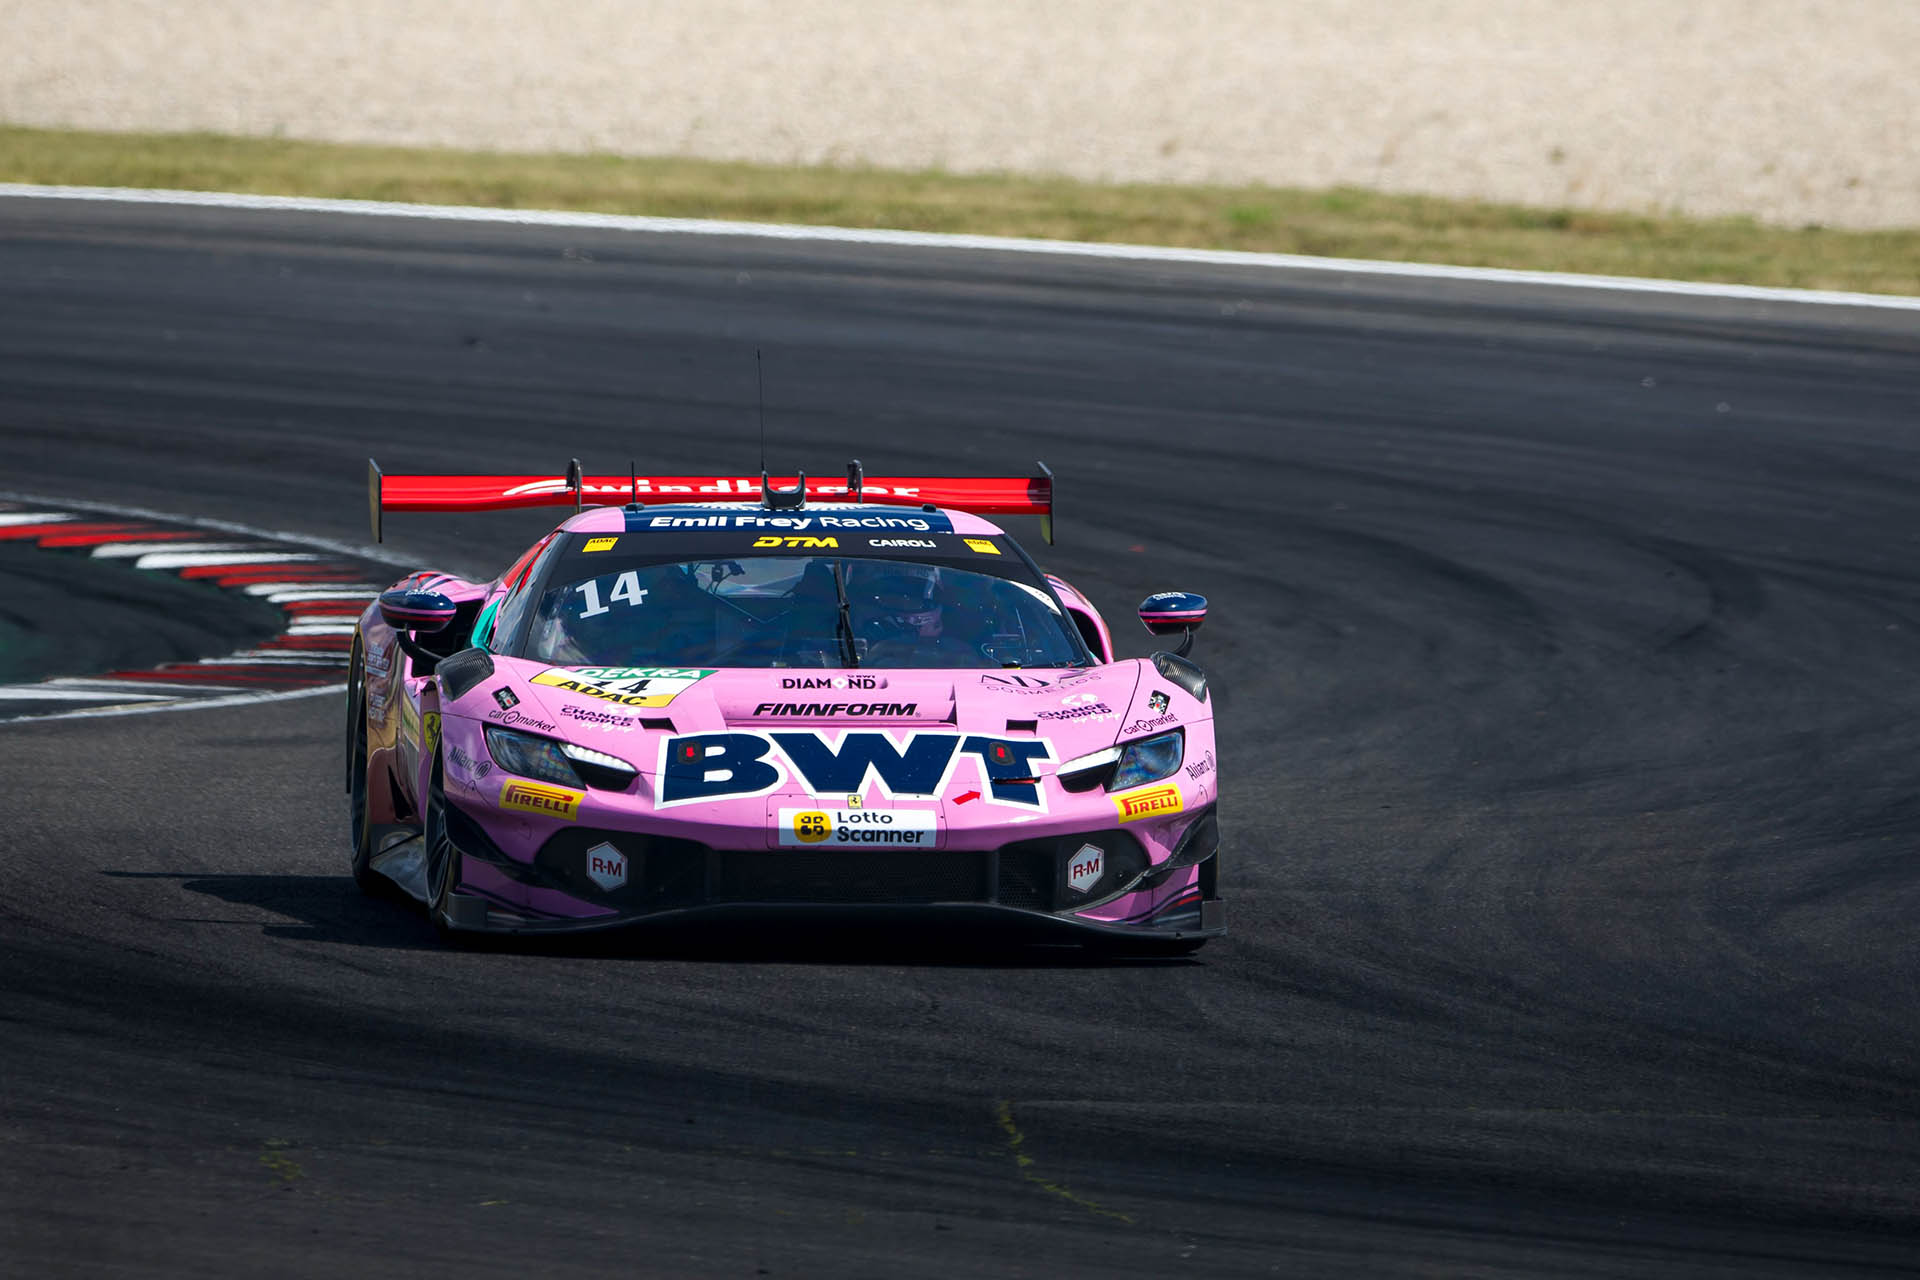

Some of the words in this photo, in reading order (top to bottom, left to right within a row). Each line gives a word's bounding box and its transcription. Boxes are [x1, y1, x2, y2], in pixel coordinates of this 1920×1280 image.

[650, 516, 727, 527] Emil
[735, 516, 812, 530] Frey
[819, 516, 930, 531] Racing
[752, 536, 839, 547] DTM
[868, 539, 937, 548] CAIROLI
[575, 570, 649, 619] 14
[578, 667, 701, 679] DEKRA
[557, 680, 647, 705] ADAC
[659, 730, 1056, 810] BWT
[505, 784, 575, 814] PIRELLI
[1120, 789, 1178, 816] PIRELLI
[837, 812, 893, 824] Lotto
[837, 826, 924, 843] Scanner
